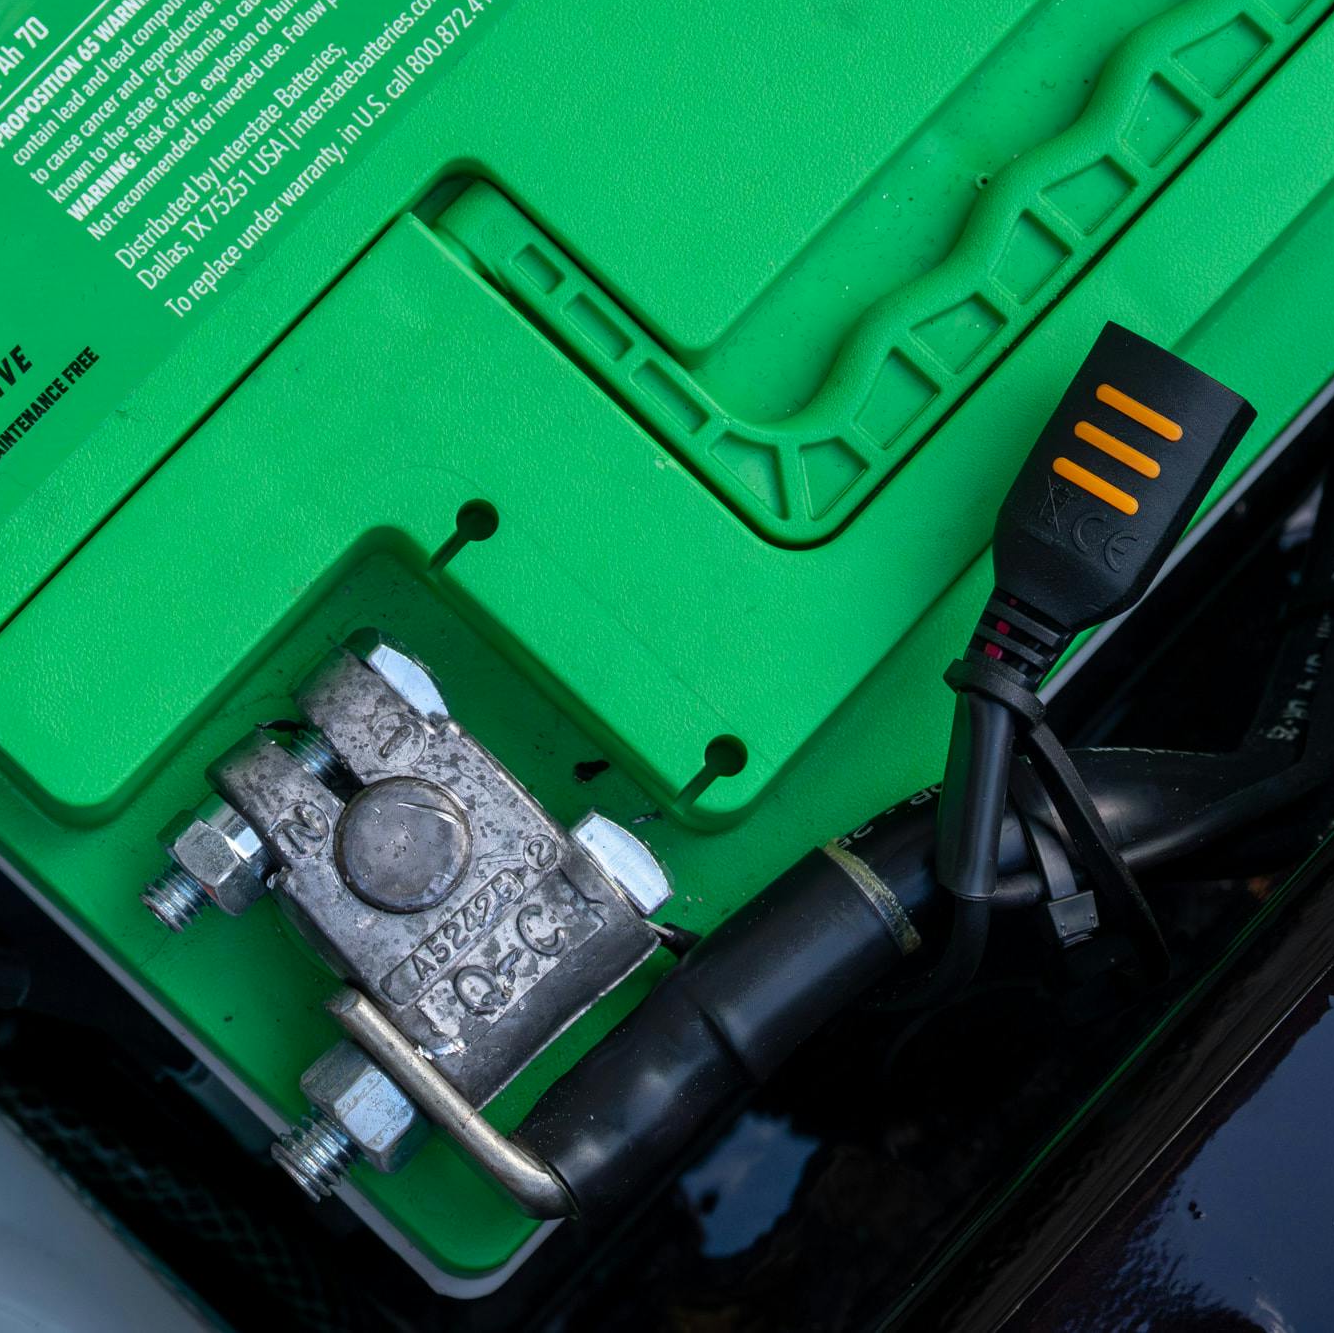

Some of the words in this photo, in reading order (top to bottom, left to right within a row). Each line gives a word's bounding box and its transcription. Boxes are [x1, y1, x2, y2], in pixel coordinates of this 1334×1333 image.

[13, 16, 49, 49] 70
[76, 35, 101, 62] 65
[66, 150, 141, 222] WARNING:
[133, 124, 168, 155] Risk
[162, 106, 180, 129] of
[171, 91, 206, 116] fire,
[200, 32, 260, 91] explosion
[255, 16, 273, 36] or
[114, 182, 201, 270] Distributed
[189, 167, 222, 193] by
[209, 104, 283, 174] Interstate
[273, 43, 348, 109] Batteries,
[164, 296, 192, 318] To
[187, 245, 242, 301] replace
[237, 201, 284, 250] under
[277, 142, 348, 207] warranty,
[336, 124, 362, 145] in
[351, 94, 391, 127] U.S.
[385, 65, 415, 99] call
[136, 241, 194, 291] Dallas,
[181, 214, 212, 242] TX
[199, 169, 256, 224] 75251
[247, 138, 290, 176] USA
[61, 346, 100, 385] FREE
